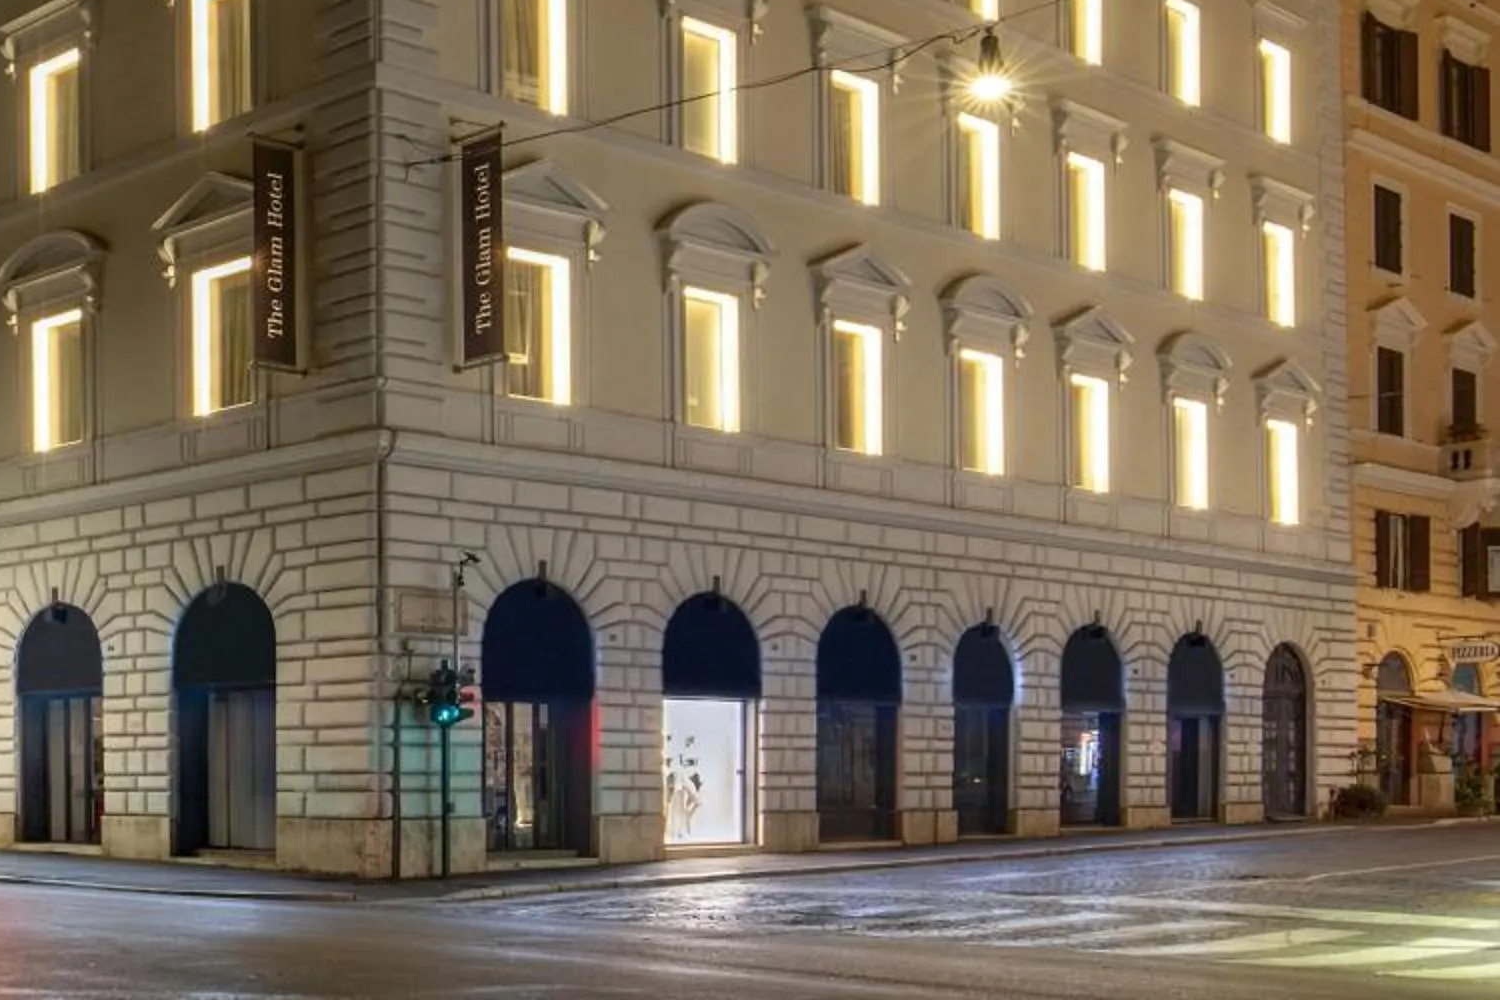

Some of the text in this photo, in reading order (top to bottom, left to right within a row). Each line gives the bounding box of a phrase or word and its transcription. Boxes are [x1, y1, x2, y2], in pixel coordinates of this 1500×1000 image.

[267, 172, 283, 339] The Glam Hotel
[474, 162, 491, 335] The Glam Hotel
[1451, 645, 1496, 660] PIZZERIA
